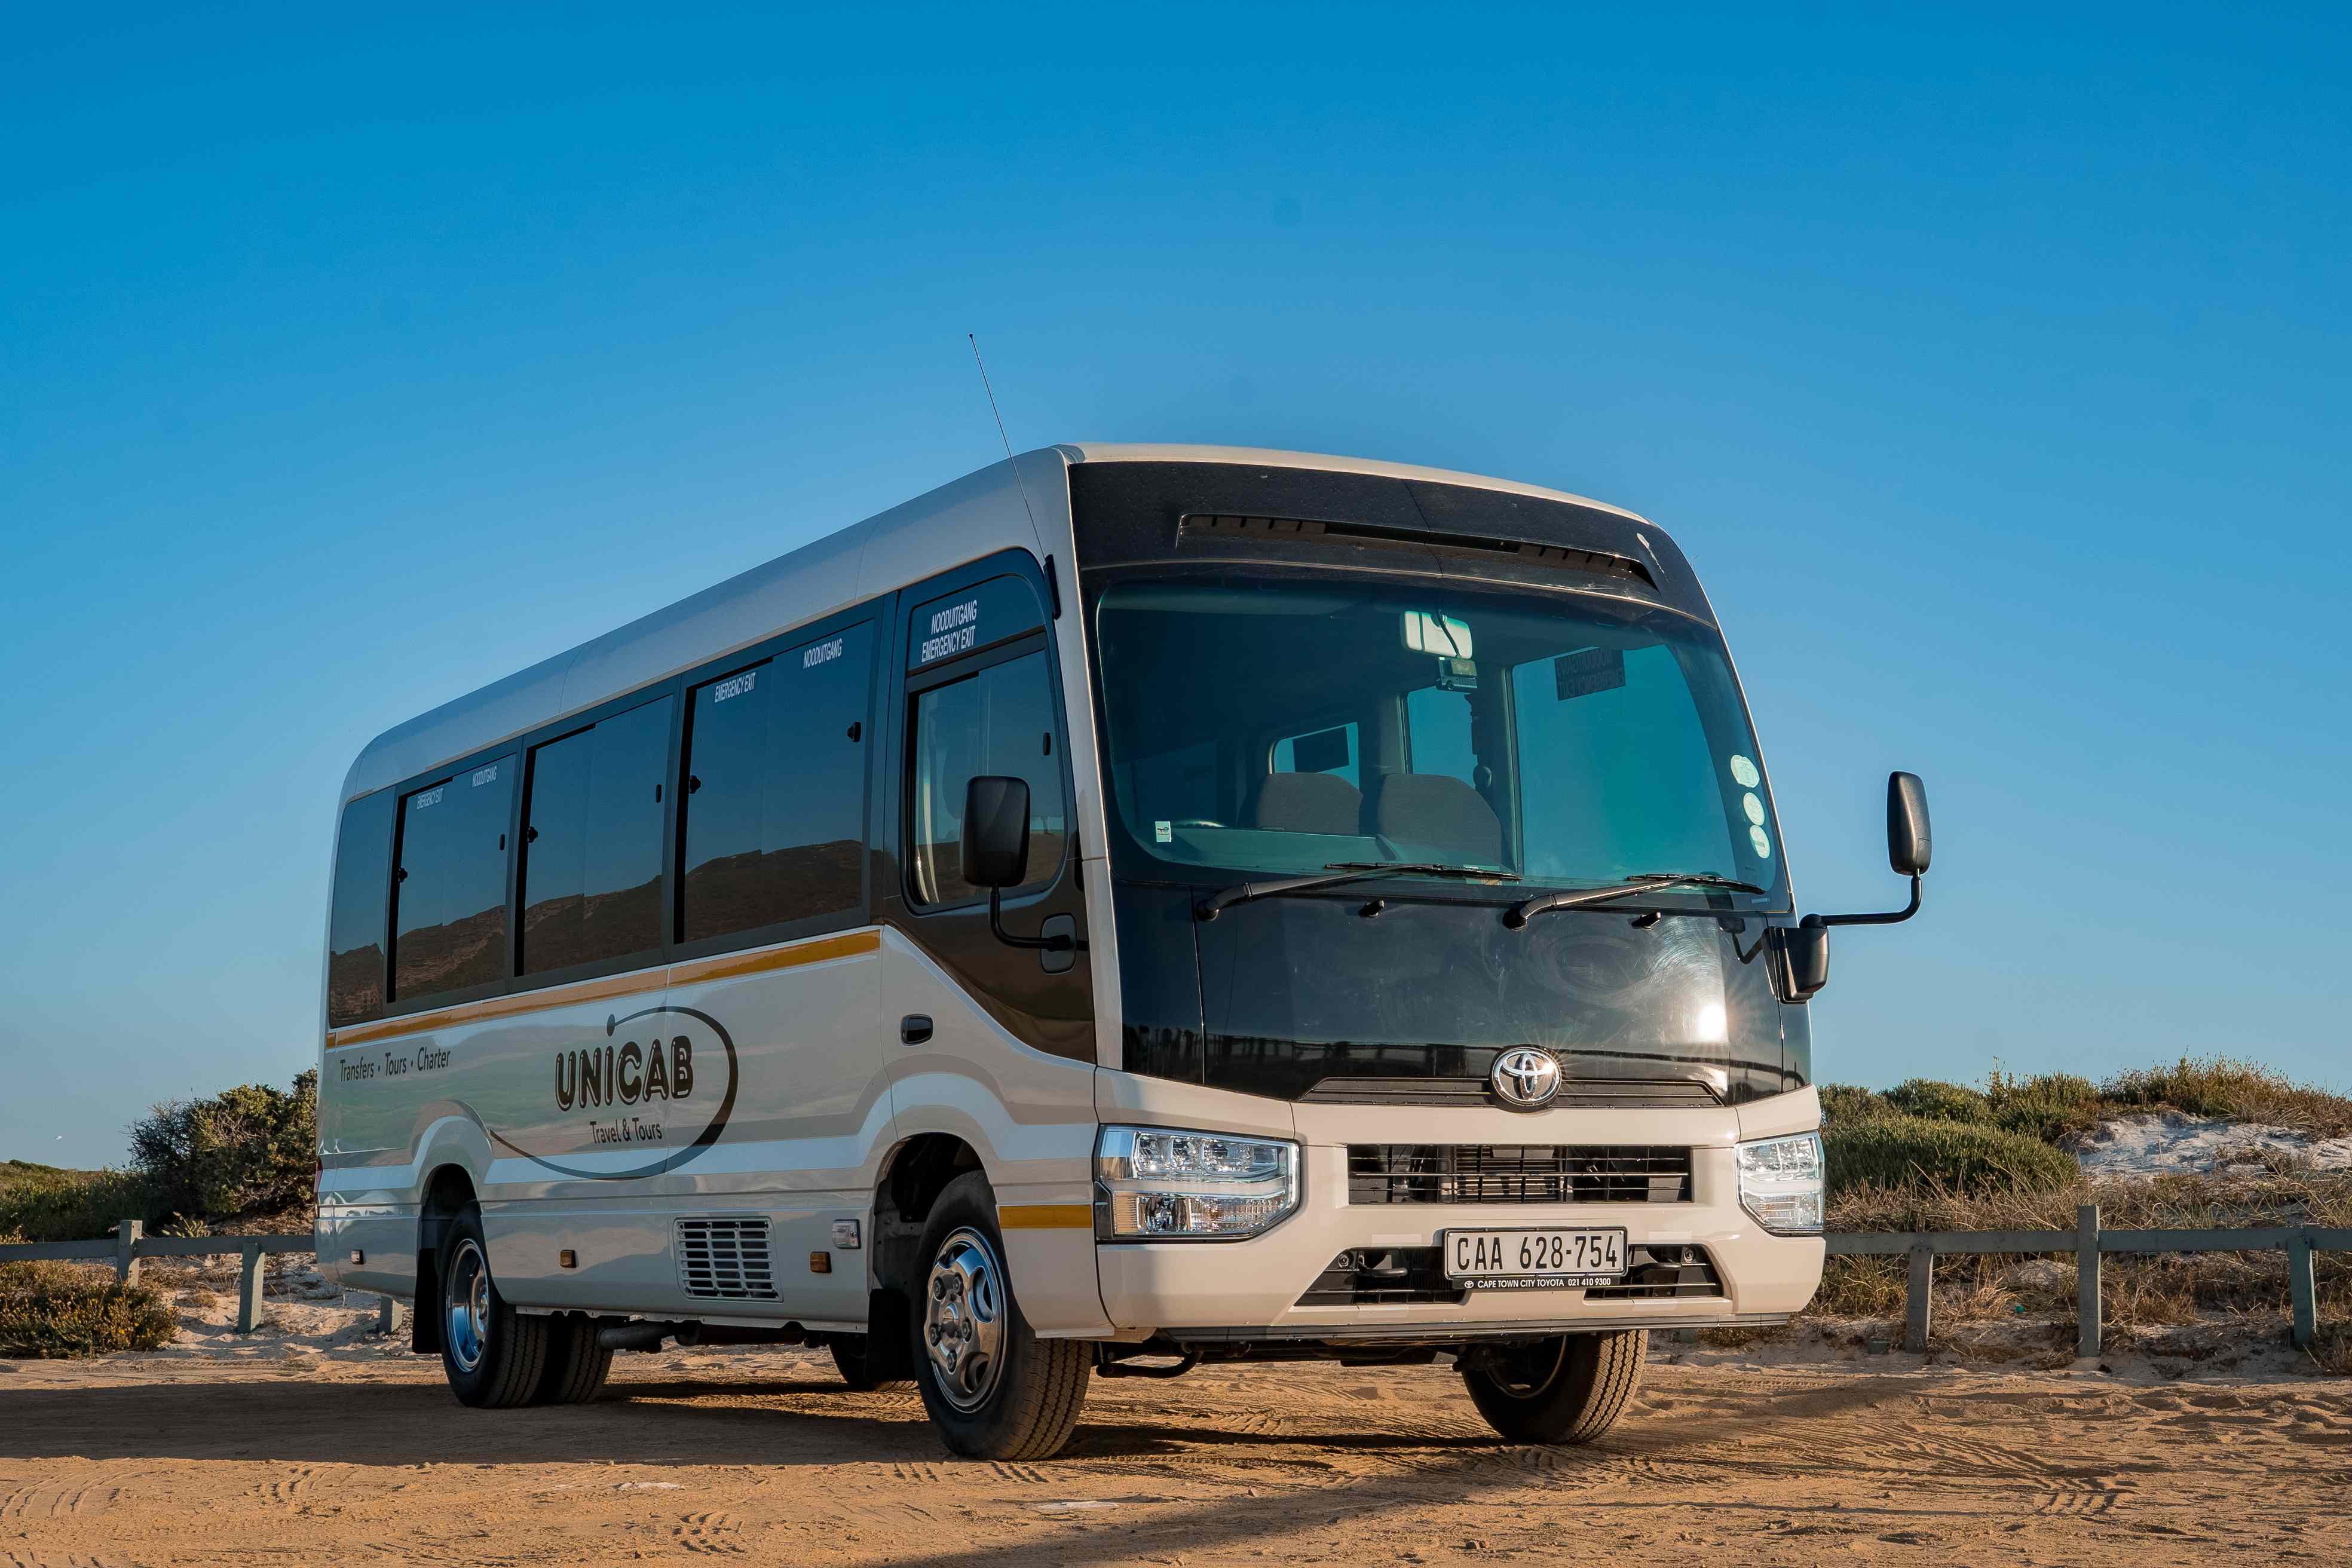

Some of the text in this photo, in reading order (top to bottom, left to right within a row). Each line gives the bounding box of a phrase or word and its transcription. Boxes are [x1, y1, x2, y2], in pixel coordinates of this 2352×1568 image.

[931, 599, 977, 635] NOODUITGANG
[803, 638, 843, 669] NOODUITGANG
[921, 625, 976, 663] EMERGENCY EXIT
[714, 672, 756, 703] EMERGENCY EXIT
[339, 1046, 451, 1082] Transfers Tours Charter
[589, 1117, 663, 1144] Travel & Tours
[1457, 1235, 1617, 1270] CAA 628-754
[1537, 1279, 1564, 1287] TOYOTA
